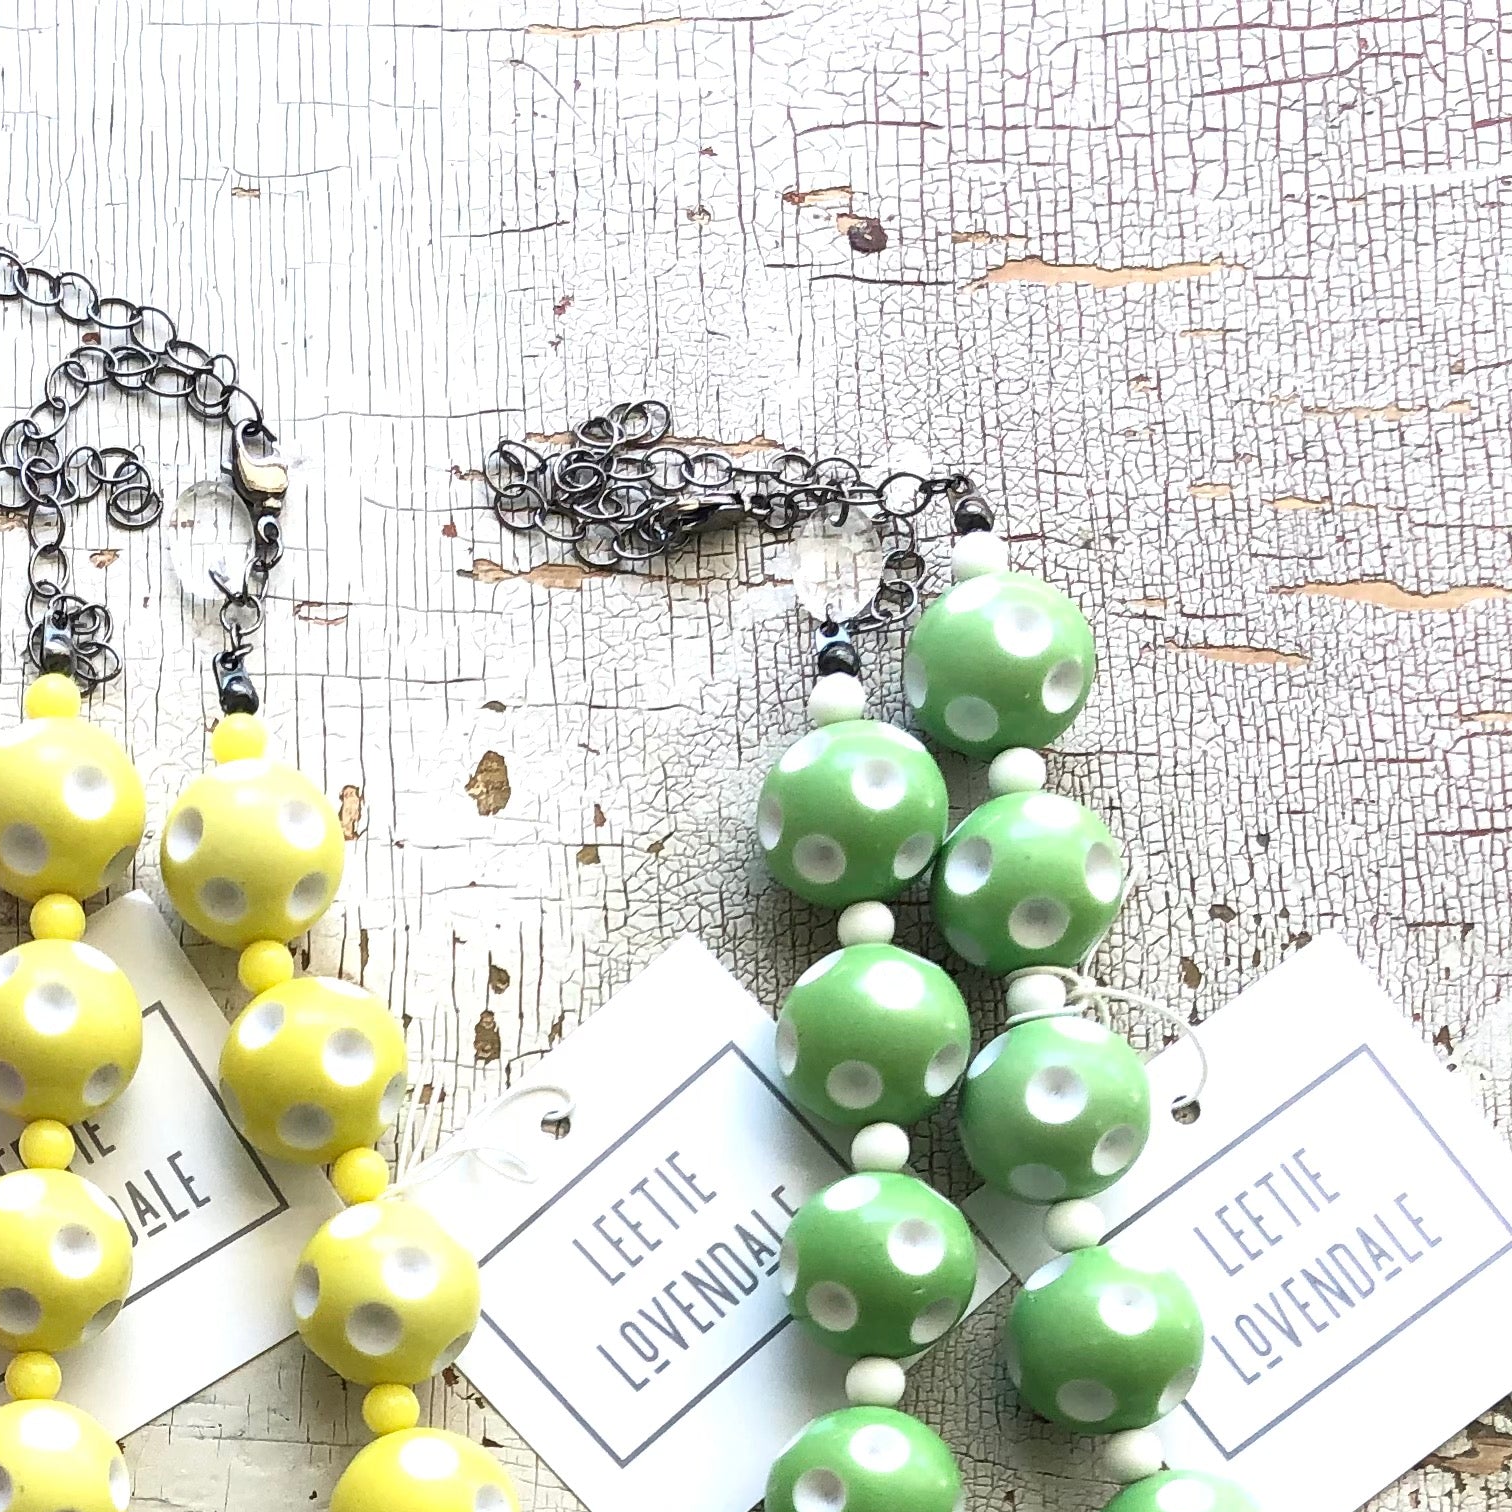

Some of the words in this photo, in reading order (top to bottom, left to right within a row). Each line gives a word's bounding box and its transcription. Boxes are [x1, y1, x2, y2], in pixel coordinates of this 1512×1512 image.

[572, 1150, 718, 1286] LEETIE
[1193, 1147, 1341, 1278] LEETIE
[1211, 1192, 1443, 1386] LOVENDALE
